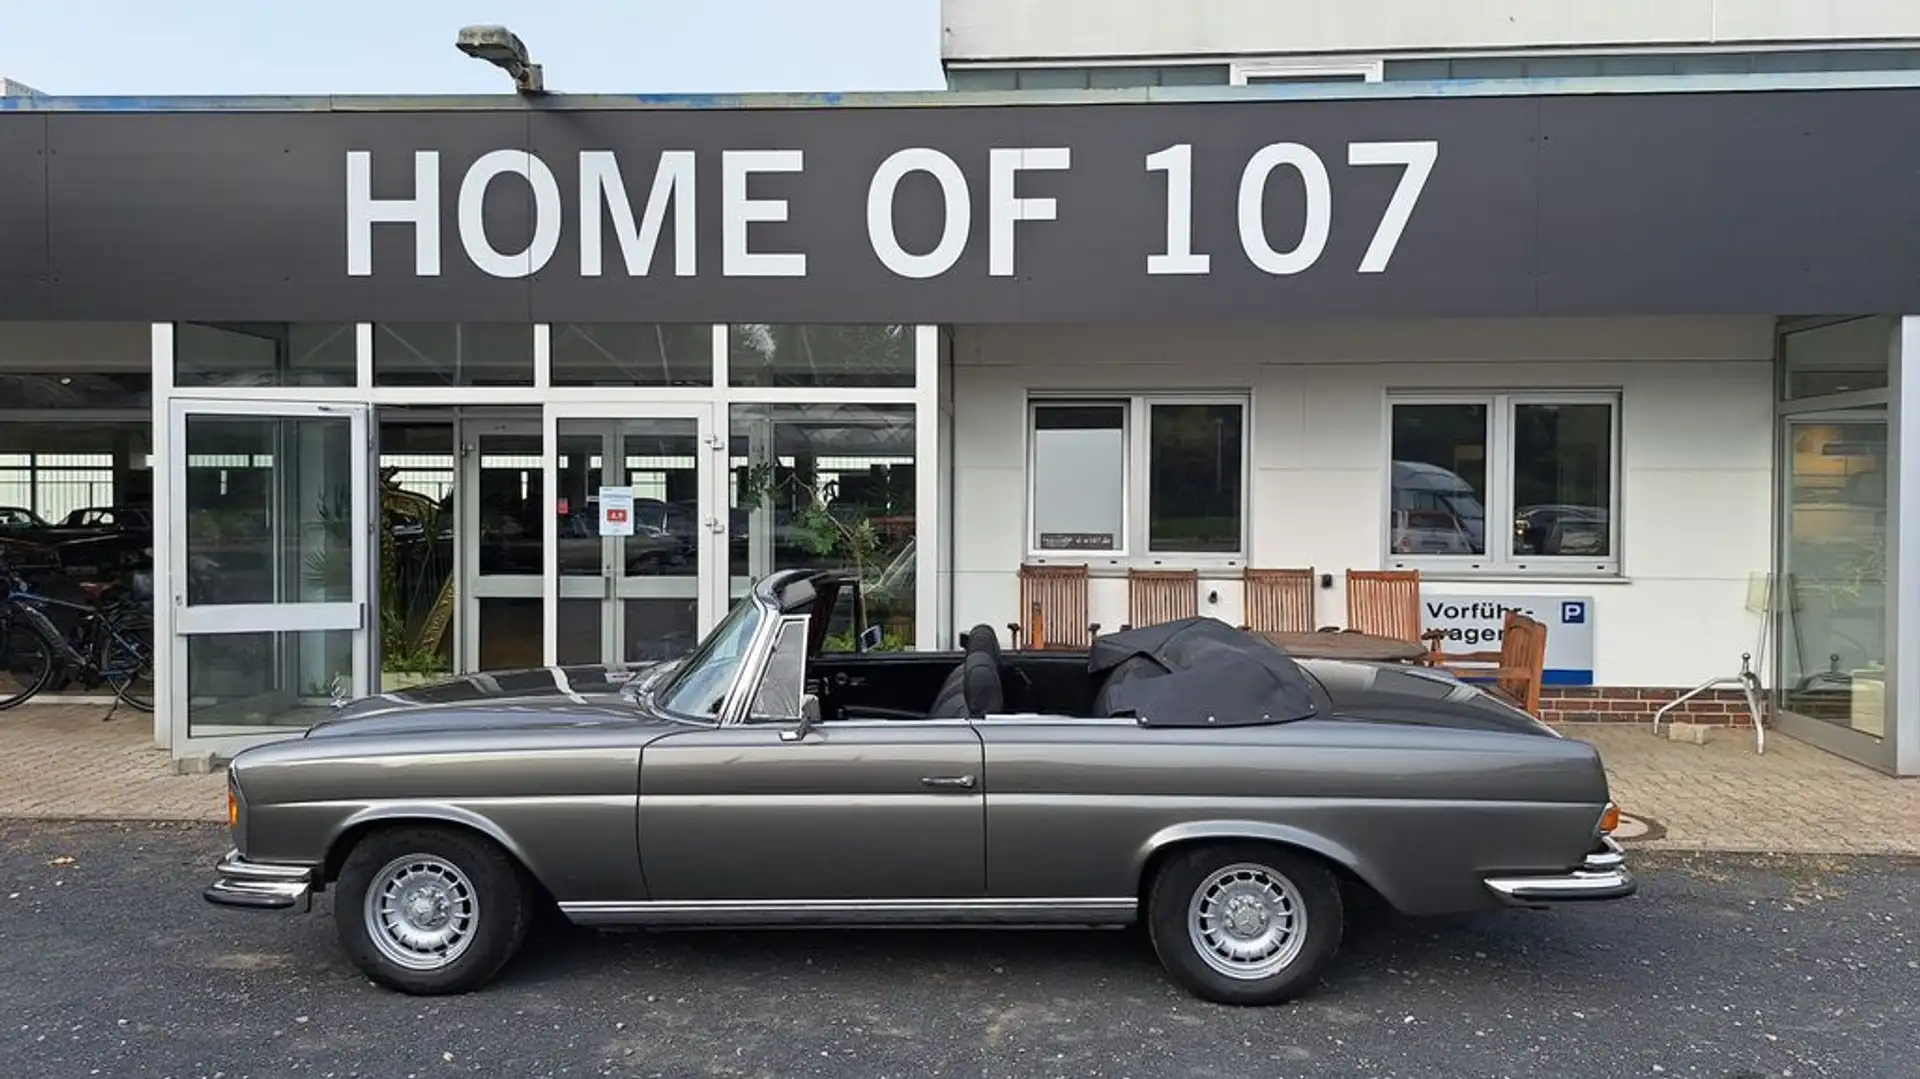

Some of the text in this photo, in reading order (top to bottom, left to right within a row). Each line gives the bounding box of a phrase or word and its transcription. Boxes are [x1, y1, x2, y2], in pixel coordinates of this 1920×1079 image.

[346, 140, 1439, 279] HOME OF 107
[1564, 605, 1581, 621] P
